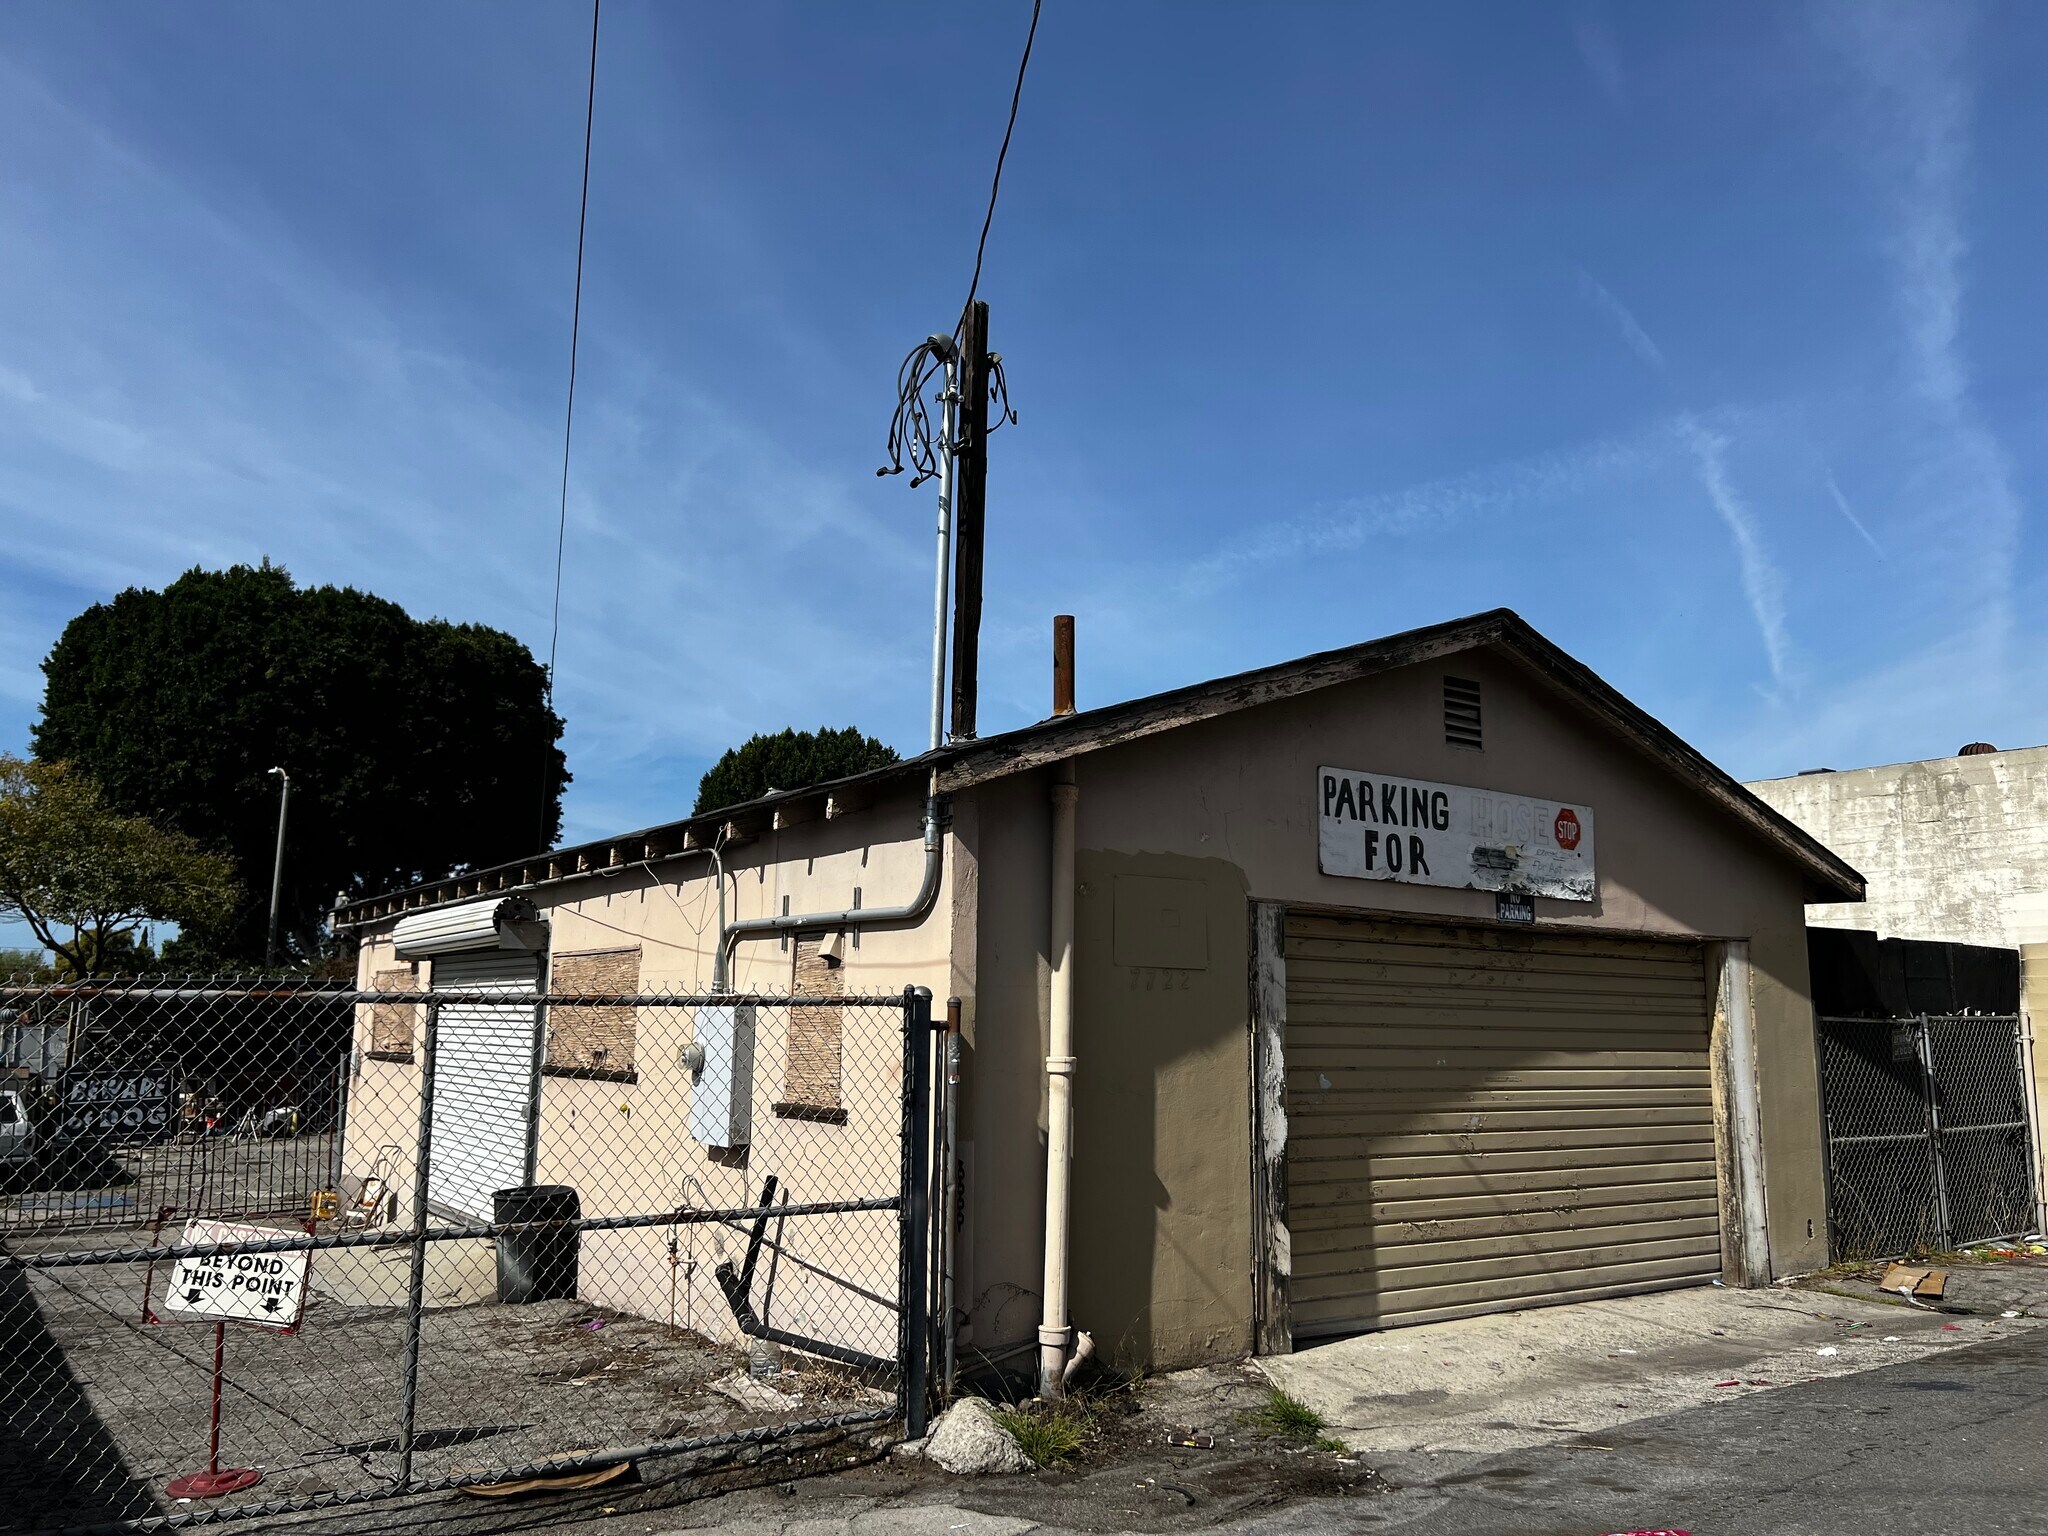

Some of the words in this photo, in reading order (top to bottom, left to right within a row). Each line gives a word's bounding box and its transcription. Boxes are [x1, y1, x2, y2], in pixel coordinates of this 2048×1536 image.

[1323, 775, 1449, 831] PARKING
[1558, 820, 1578, 840] STOP
[1365, 830, 1430, 876] FOR
[1500, 903, 1531, 920] PARKING
[70, 1077, 168, 1101] BEWARE
[99, 1105, 167, 1128] DOG
[200, 1254, 283, 1275] BEYOND
[182, 1268, 224, 1288] THIS
[231, 1274, 294, 1296] POINT
